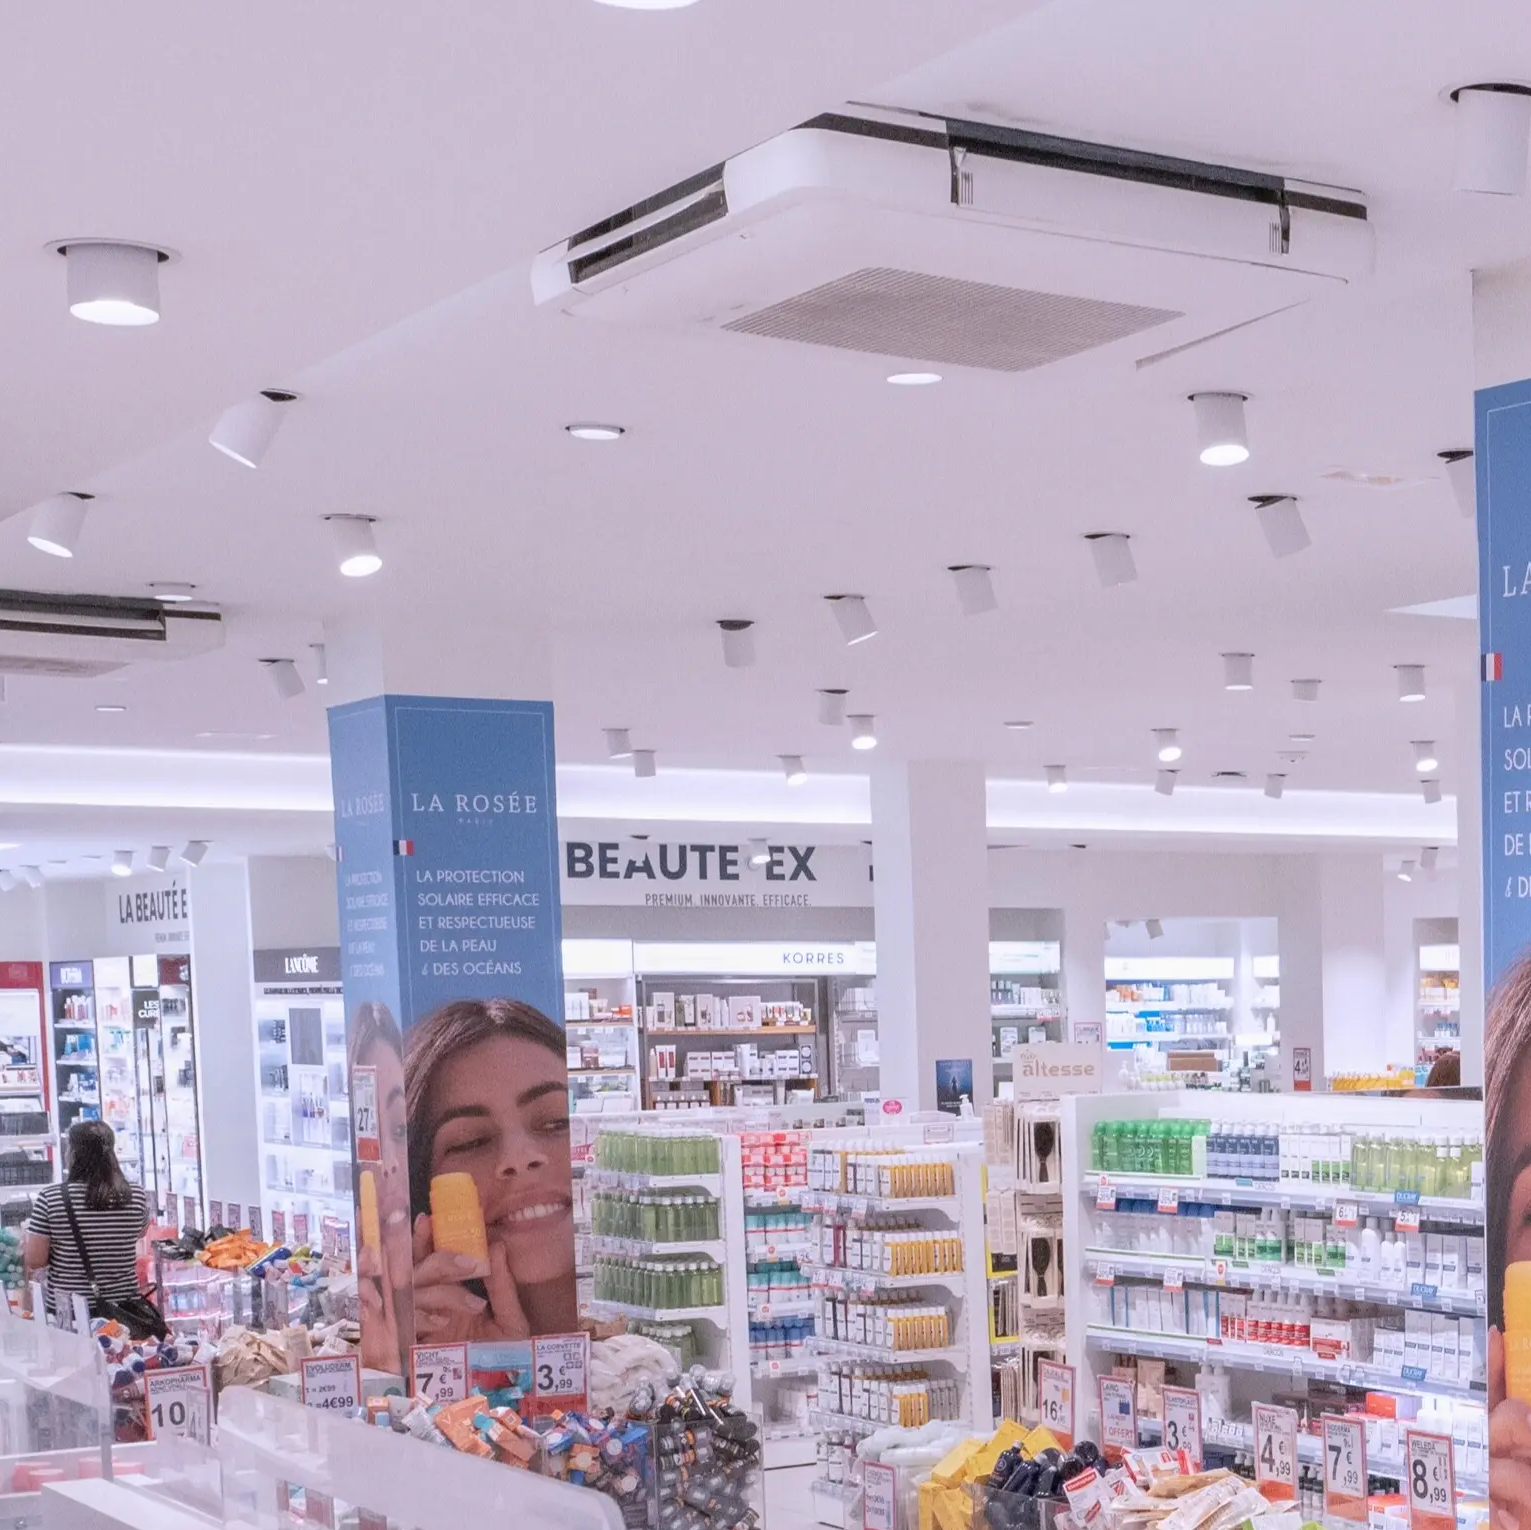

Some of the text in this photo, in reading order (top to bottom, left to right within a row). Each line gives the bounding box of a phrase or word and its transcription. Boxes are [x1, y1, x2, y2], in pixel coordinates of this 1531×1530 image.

[1504, 704, 1523, 729] LA
[412, 791, 538, 813] LA ROSÉE
[1504, 792, 1520, 813] ET
[1504, 835, 1523, 856] DE
[417, 869, 525, 885] LA PROTECTION
[119, 882, 178, 923] LA BEAUTÉ
[418, 893, 540, 906] SOLAIRE EFFICACE
[419, 916, 536, 930] ET RESPECTUEUSE
[420, 939, 497, 953] DE LA PEAU
[285, 953, 319, 974] LANCÔME
[783, 952, 844, 964] KORRES
[433, 959, 522, 975] DES OCÉANS
[1023, 1060, 1095, 1077] altesse
[416, 1350, 438, 1360] VICHY
[149, 1374, 201, 1387] ARKOPHARMA
